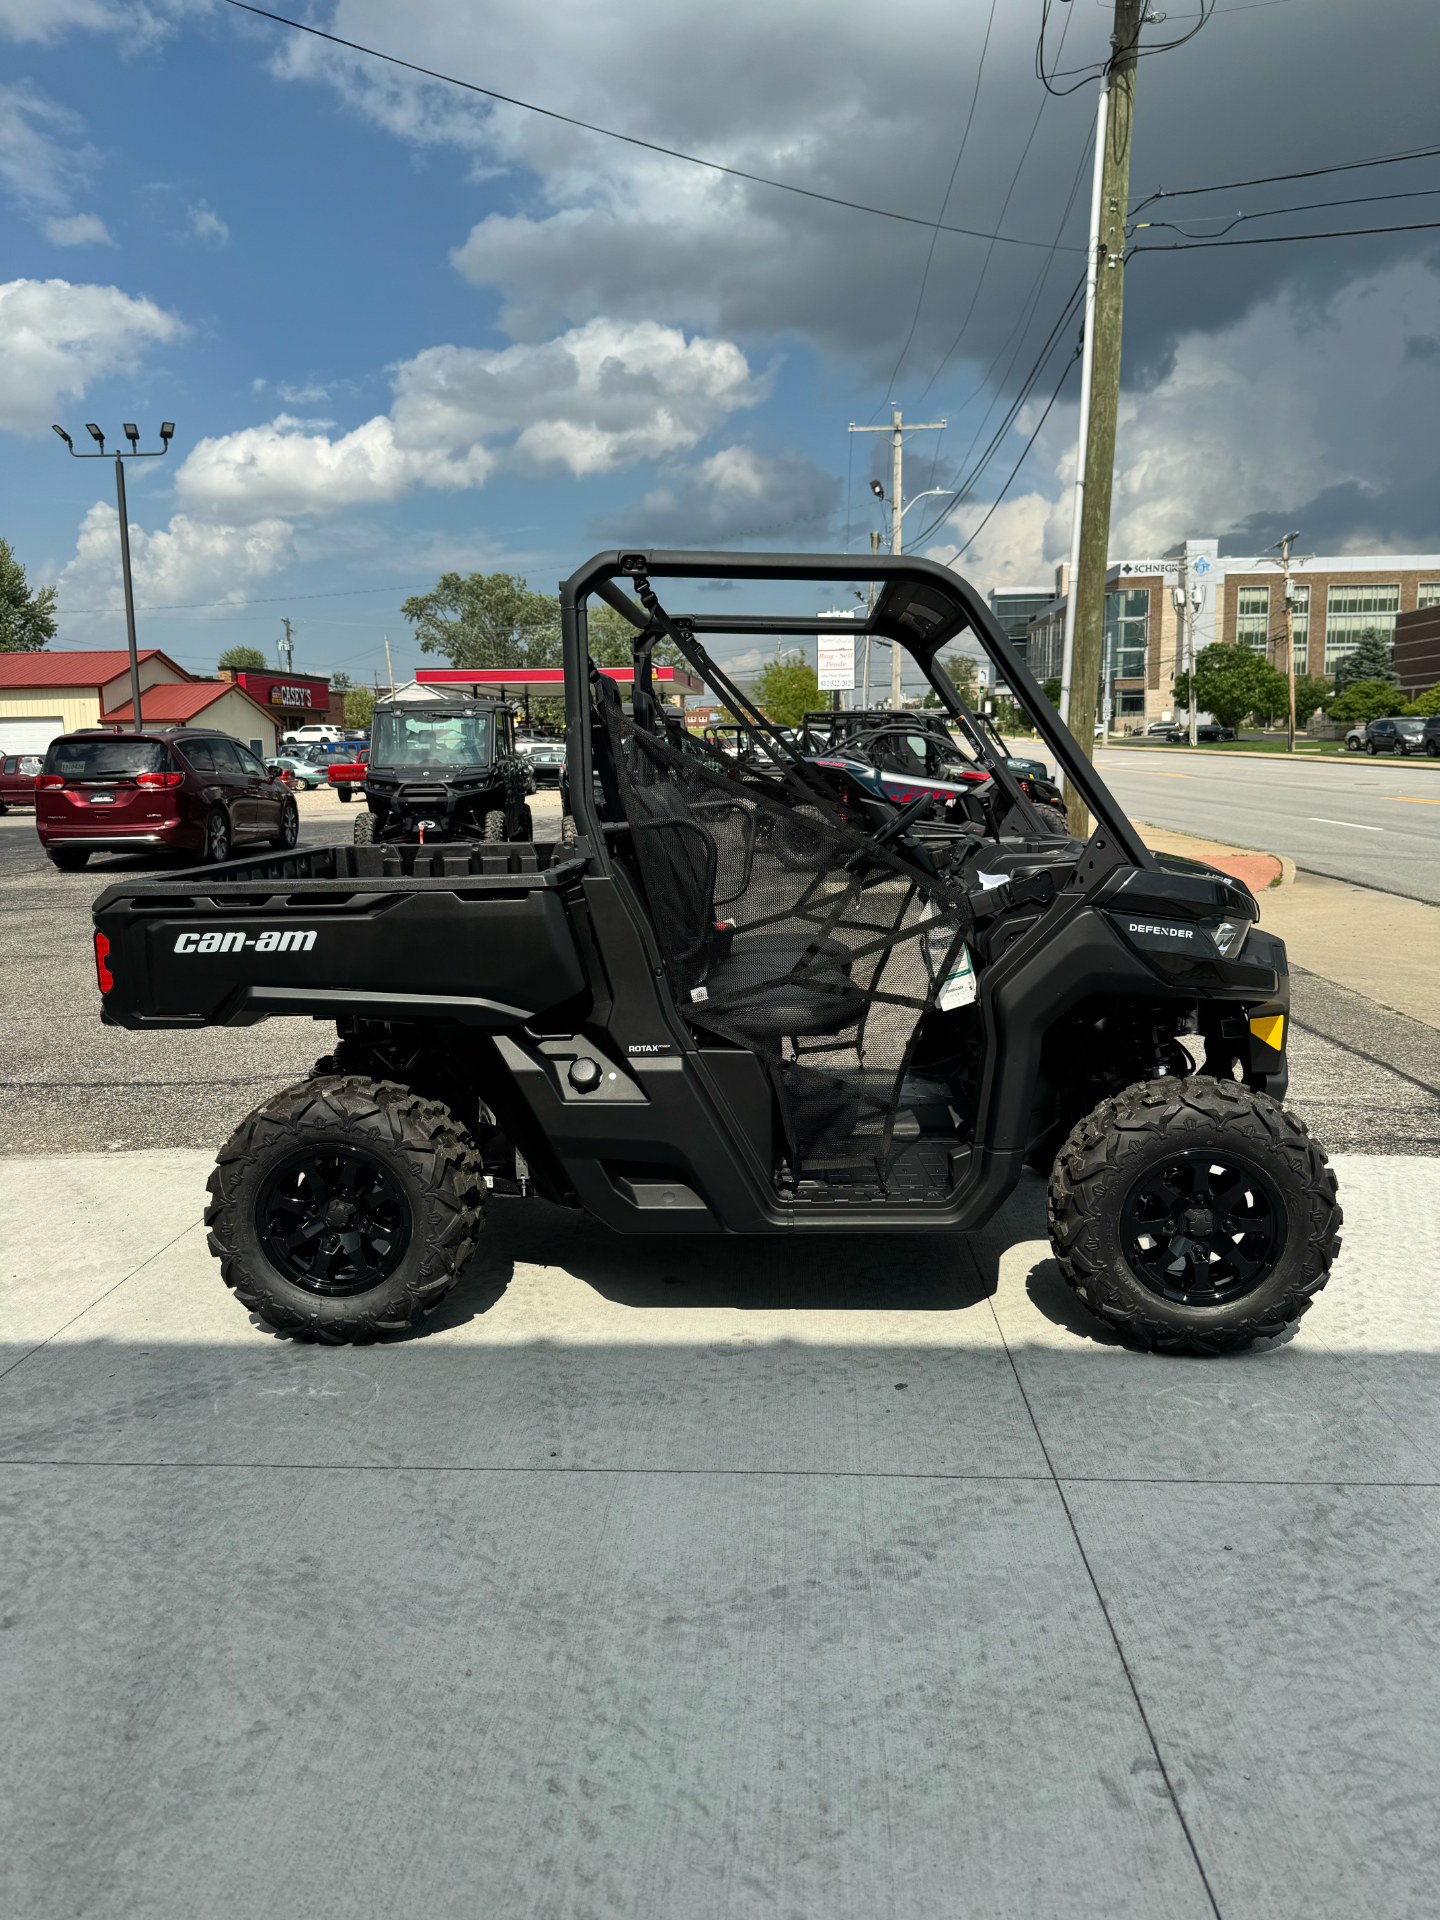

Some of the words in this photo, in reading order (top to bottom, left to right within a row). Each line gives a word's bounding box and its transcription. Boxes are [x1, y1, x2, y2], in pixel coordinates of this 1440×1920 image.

[1133, 564, 1179, 573] SCHNECK
[281, 685, 312, 707] CASEY'S
[1129, 923, 1194, 939] DEFENDER
[173, 930, 318, 954] can-am
[628, 1044, 659, 1053] ROTAX
